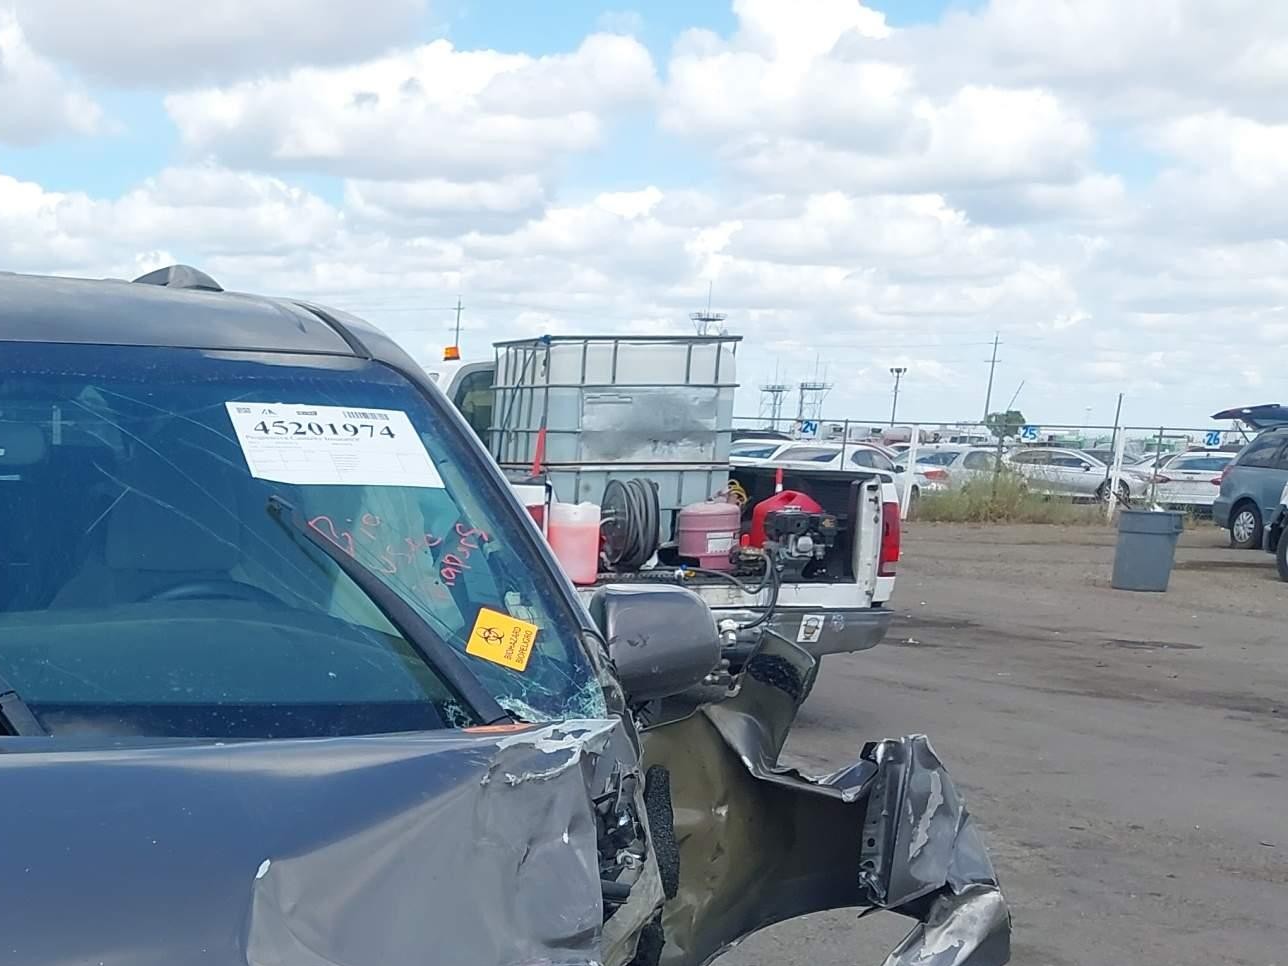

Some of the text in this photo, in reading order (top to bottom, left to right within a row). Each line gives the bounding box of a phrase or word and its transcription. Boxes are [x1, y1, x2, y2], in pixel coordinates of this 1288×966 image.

[254, 420, 396, 438] 45201974
[802, 420, 817, 436] 24
[1022, 425, 1037, 440] 25
[1206, 431, 1220, 445] 26
[504, 626, 522, 660] BIOHAZARD
